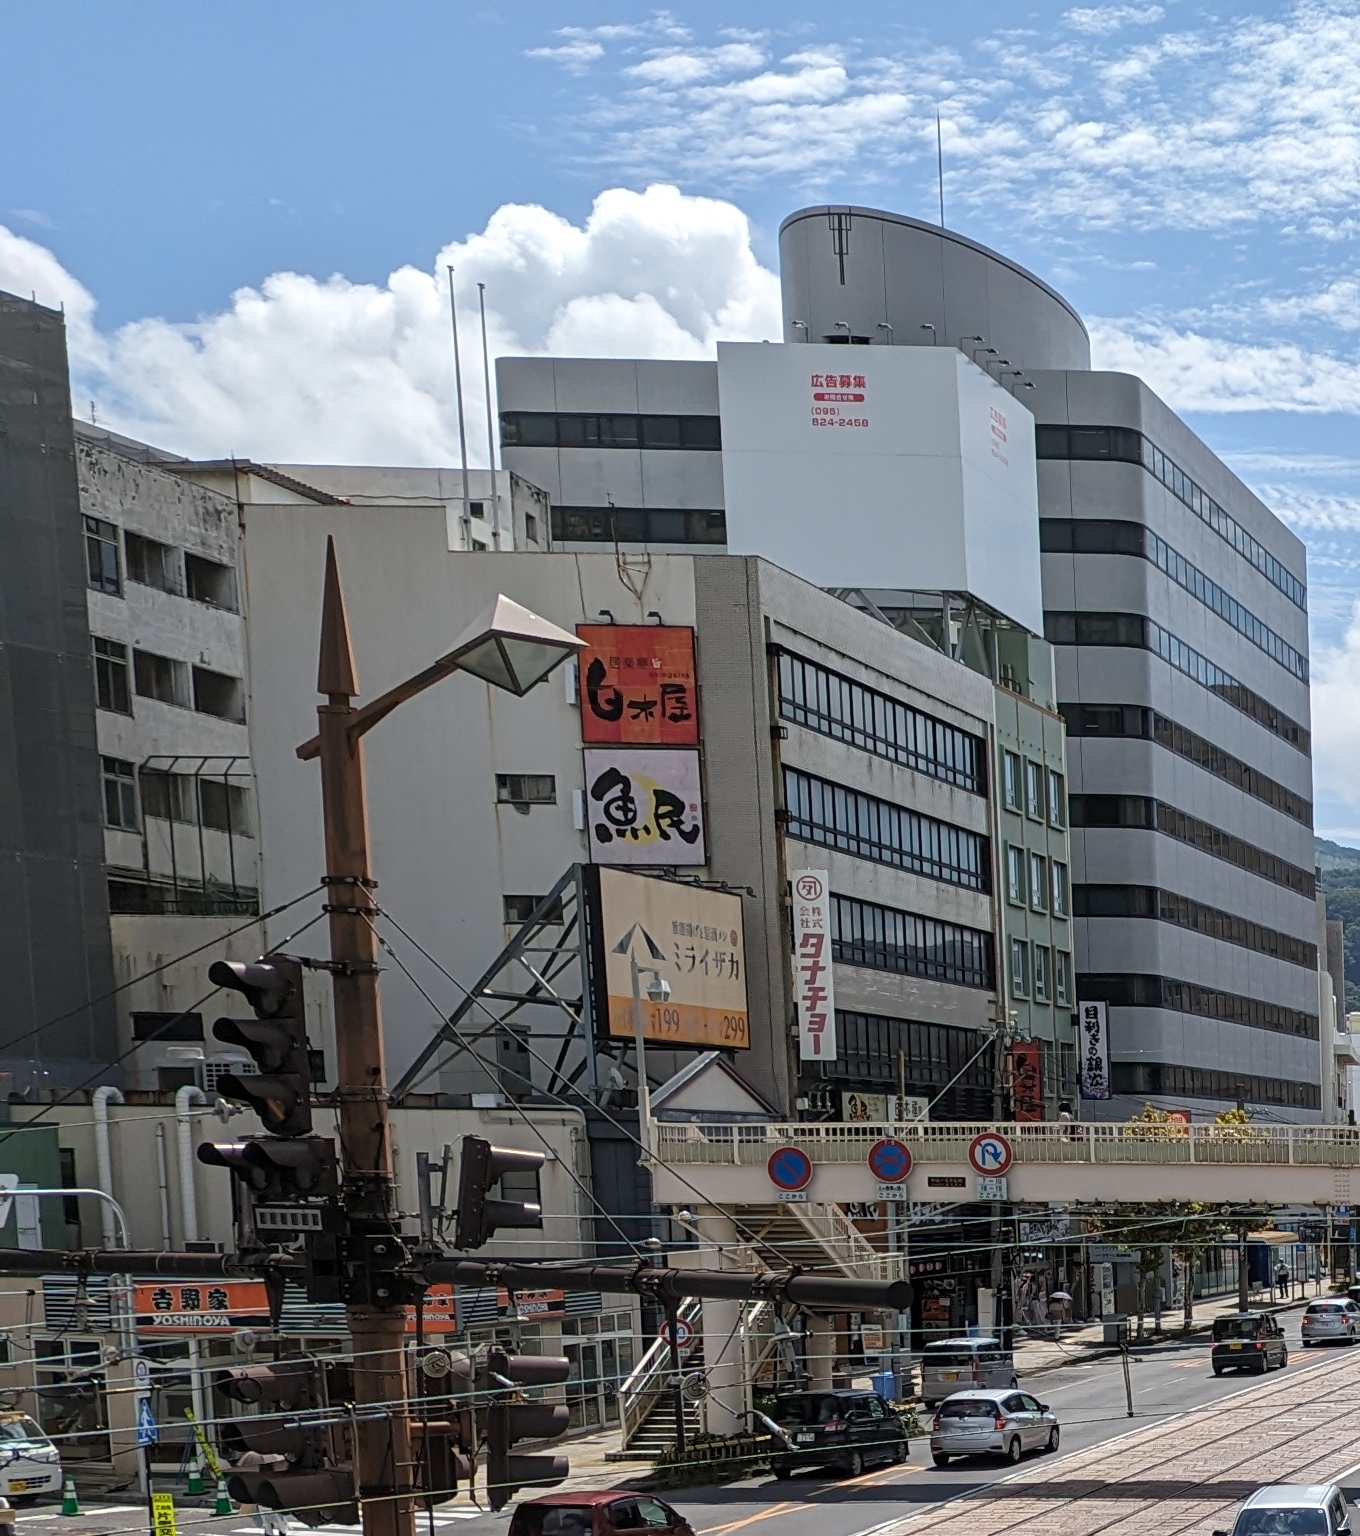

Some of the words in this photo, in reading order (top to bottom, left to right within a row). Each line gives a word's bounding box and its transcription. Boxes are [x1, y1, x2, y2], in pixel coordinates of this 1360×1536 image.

[811, 374, 867, 389] 広告募集
[587, 657, 692, 724] 白木屋
[590, 766, 701, 845] 魚民
[673, 942, 740, 981] ミライザカ
[799, 932, 829, 1055] タナチョー
[1084, 1005, 1104, 1087] 目利きの銀次
[777, 1192, 805, 1200] ここから
[878, 1192, 904, 1200] ここから
[978, 1192, 1006, 1200] ここから
